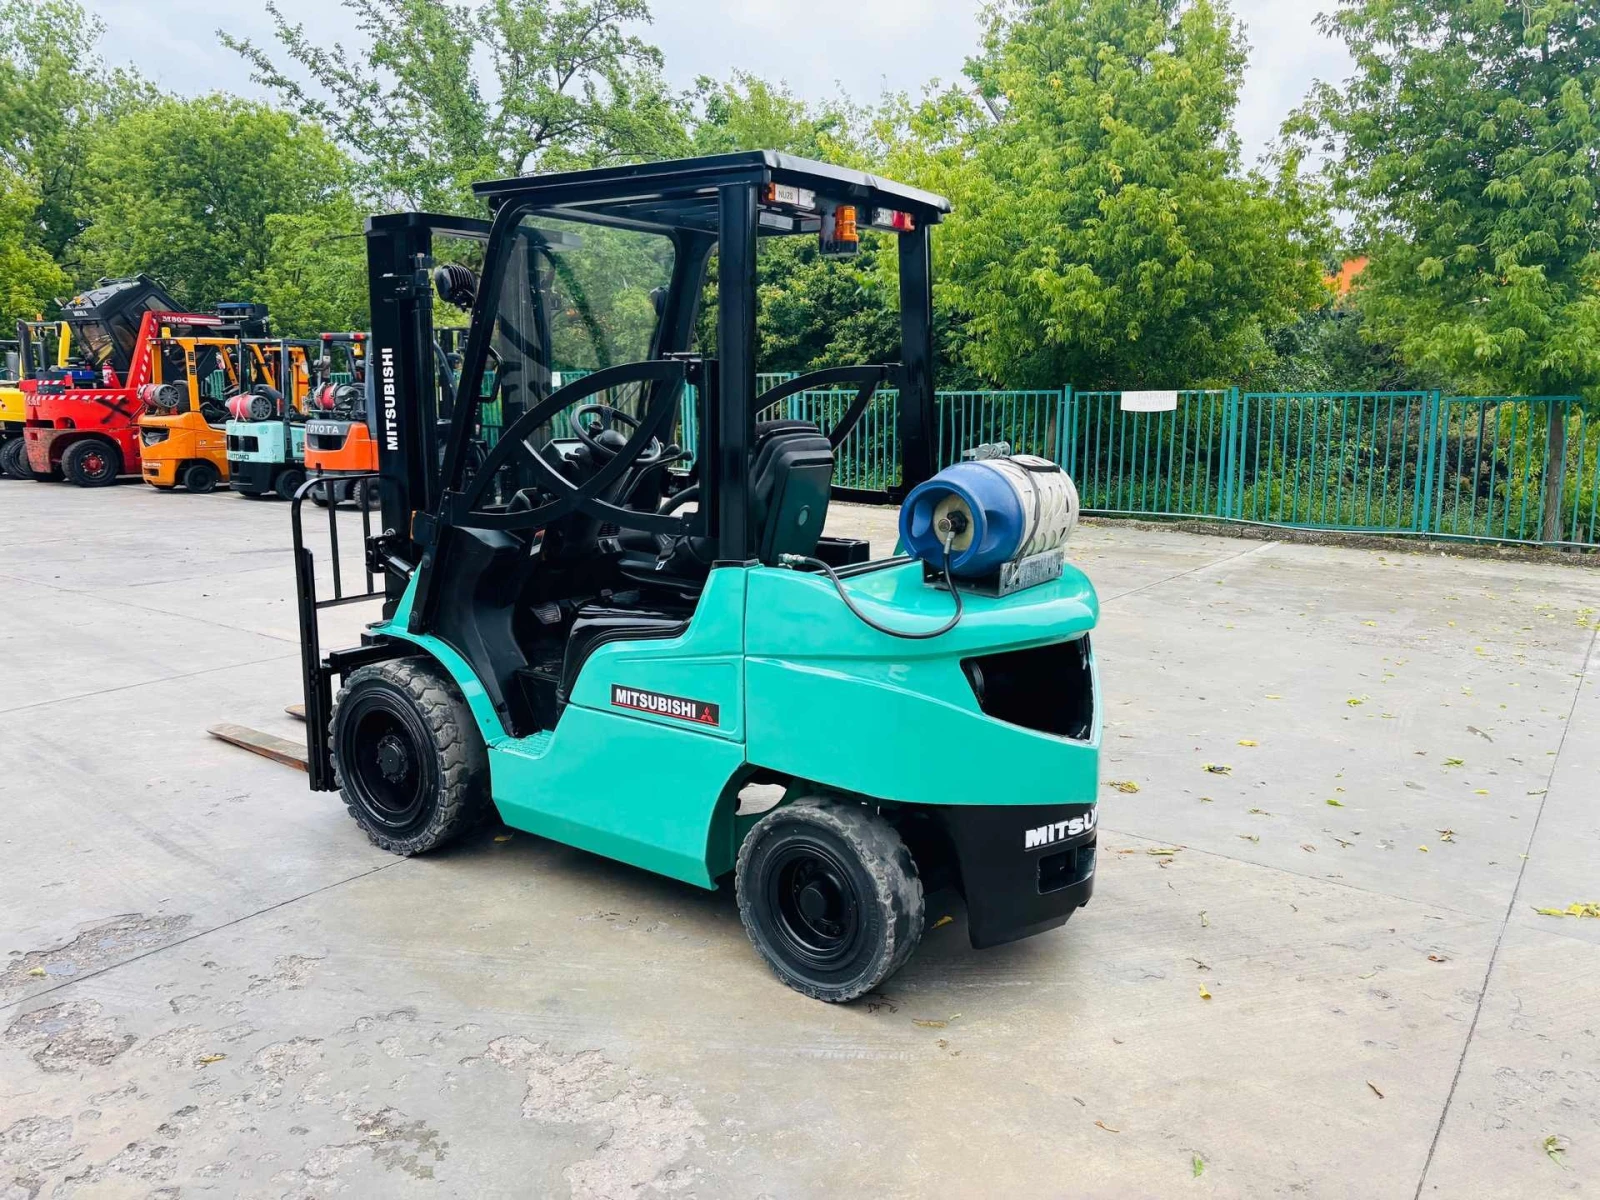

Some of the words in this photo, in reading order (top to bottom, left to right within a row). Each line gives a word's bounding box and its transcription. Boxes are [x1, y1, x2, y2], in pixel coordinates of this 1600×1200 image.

[381, 347, 399, 451] MITSUBISHI
[307, 424, 339, 434] TOYOTA
[616, 688, 697, 718] MITSUBISHI
[1025, 805, 1098, 849] MITSU
